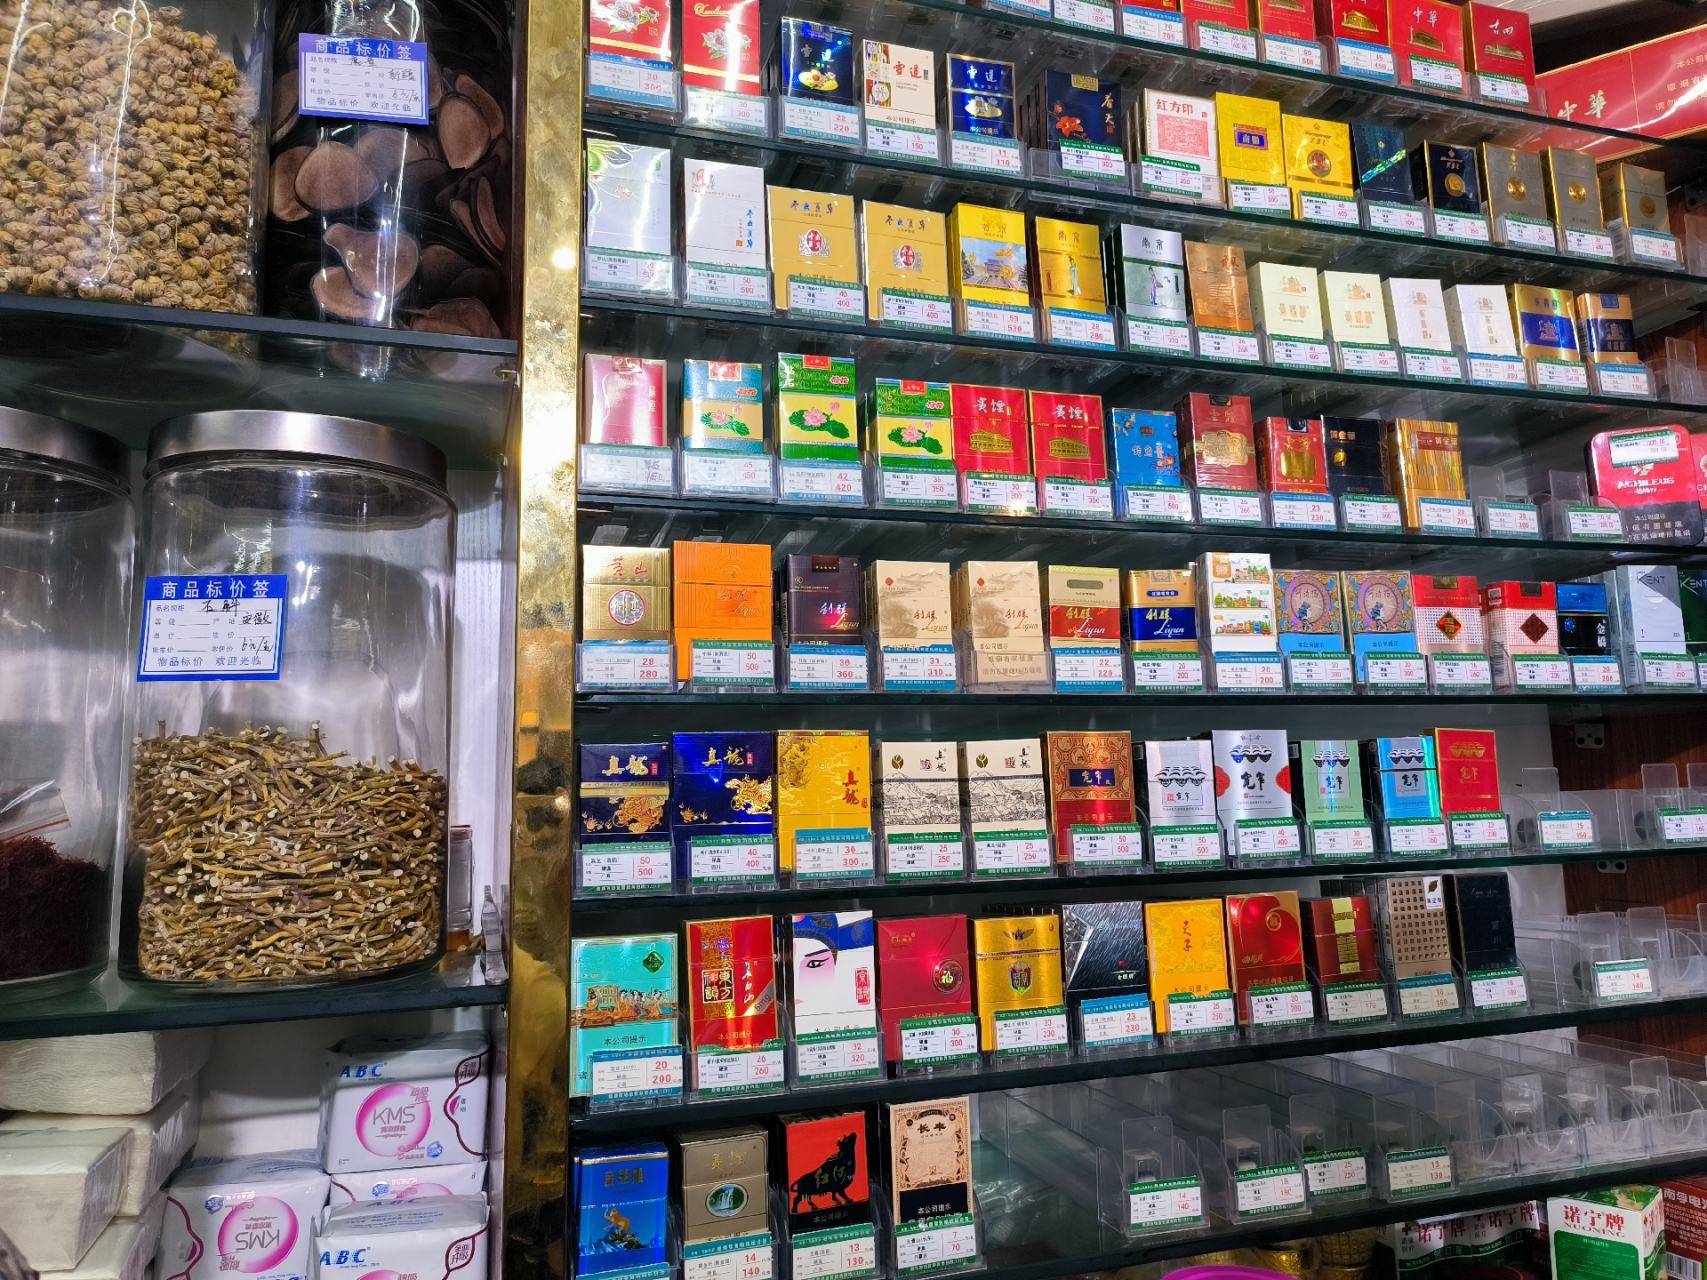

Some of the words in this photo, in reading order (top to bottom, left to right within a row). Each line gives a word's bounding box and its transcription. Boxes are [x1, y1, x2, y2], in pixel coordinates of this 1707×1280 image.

[315, 40, 412, 60] 商品标价签
[317, 98, 359, 107] 物品标价
[370, 102, 412, 112] 欢迎光临
[1156, 99, 1195, 116] 红方印
[1008, 325, 1022, 333] 530
[1091, 323, 1100, 331] 28
[1090, 332, 1103, 340] 280
[838, 473, 848, 481] 42
[836, 484, 852, 492] 420
[1312, 514, 1324, 522] 230
[607, 557, 648, 578] 黄山
[1637, 575, 1666, 586] KENT
[162, 580, 270, 599] 商品标价签
[820, 602, 847, 616] 利群
[1066, 607, 1091, 620] 利群
[914, 610, 938, 620] 利群
[1006, 609, 1028, 619] 利群
[1146, 609, 1170, 621] 利群
[831, 613, 860, 630] Liqun
[1014, 618, 1039, 631] Liqun
[922, 620, 948, 634] Liqun
[1075, 618, 1105, 635] Liqun
[1154, 618, 1185, 635] Liqun
[1299, 641, 1325, 649] 本公司提示
[158, 657, 204, 667] 物品标价
[216, 656, 262, 666] 欢迎光临
[642, 657, 654, 666] 28
[840, 659, 851, 667] 36
[930, 657, 940, 665] 31
[1099, 659, 1109, 667] 22
[746, 663, 759, 671] 500
[639, 670, 658, 678] 280
[1098, 670, 1113, 678] 220
[845, 846, 856, 854] 30
[940, 845, 948, 853] 25
[1025, 842, 1034, 850] 25
[1118, 845, 1129, 853] 500
[1197, 846, 1209, 854] 500
[640, 856, 651, 865] 50
[938, 855, 950, 864] 250
[1024, 853, 1037, 861] 250
[746, 860, 760, 868] 400
[843, 858, 860, 866] 300
[638, 868, 653, 876] 500
[1174, 985, 1210, 994] 本公司提示
[754, 994, 772, 1012] 5mg
[1127, 1013, 1137, 1021] 23
[1126, 1024, 1140, 1033] 230
[718, 1030, 753, 1041] 本公司提示
[604, 1035, 647, 1046] 本公司提示
[852, 1043, 862, 1051] 32
[757, 1055, 767, 1063] 26
[851, 1054, 865, 1063] 320
[655, 1061, 668, 1070] 20
[340, 1063, 384, 1079] ABC
[755, 1066, 769, 1076] 260
[652, 1074, 672, 1084] 200
[372, 1106, 416, 1125] KMS
[1344, 1161, 1352, 1169] 25
[1431, 1160, 1440, 1170] 13
[814, 1168, 846, 1189] 红河
[1344, 1171, 1356, 1179] 250
[1430, 1172, 1443, 1180] 130
[917, 1203, 951, 1215] 本公司提示
[1488, 1202, 1534, 1228] 诺宁牌
[1564, 1205, 1625, 1231] 诺宁牌
[1564, 1222, 1626, 1238] NUONING
[235, 1231, 282, 1252] KMS
[849, 1243, 860, 1252] 13
[320, 1249, 367, 1265] ABC
[745, 1253, 757, 1263] 14
[847, 1256, 864, 1266] 130
[743, 1267, 760, 1277] 140
